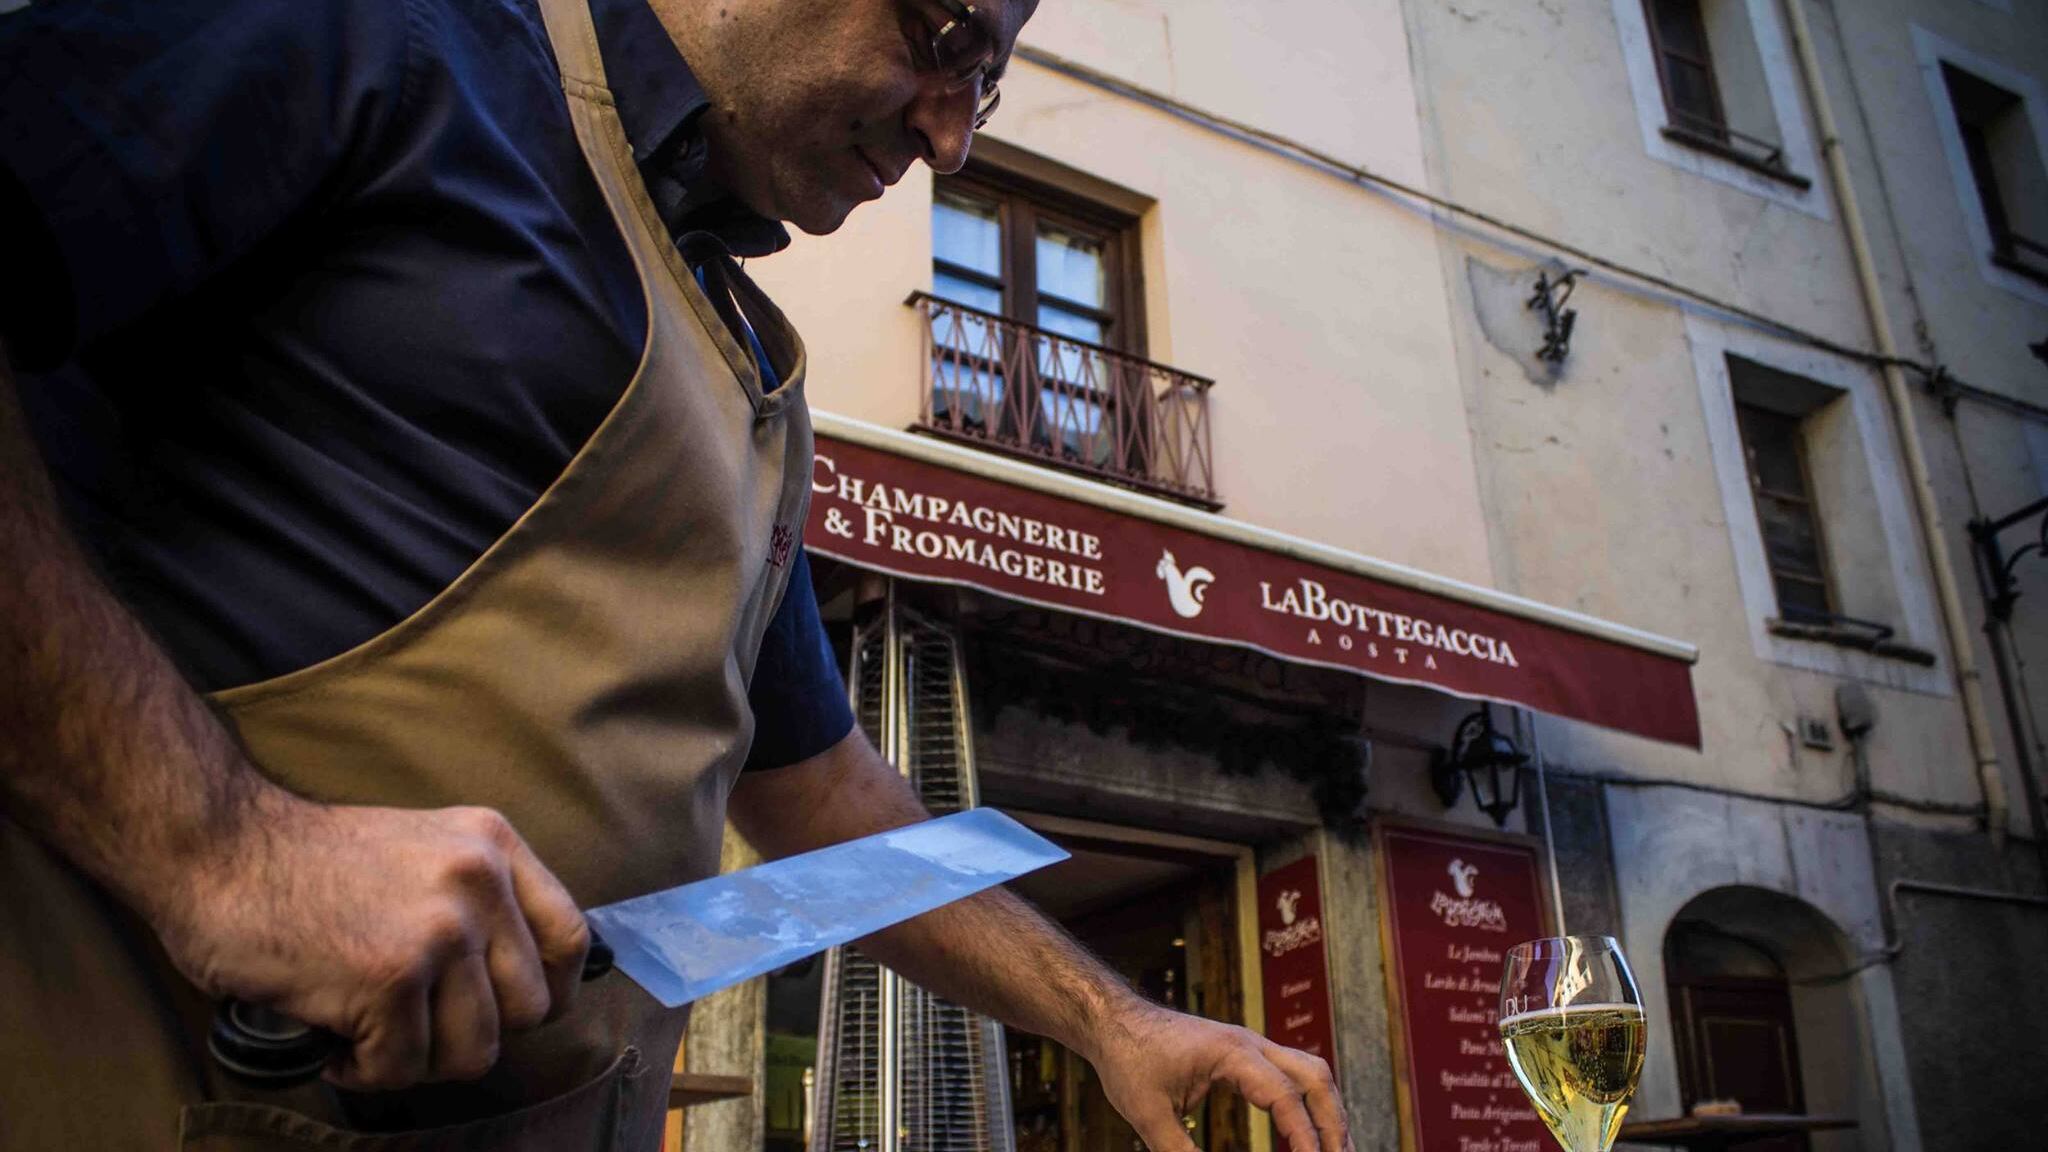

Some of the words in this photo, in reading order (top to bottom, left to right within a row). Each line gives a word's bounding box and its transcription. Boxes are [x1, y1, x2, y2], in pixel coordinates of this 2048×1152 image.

[812, 454, 1104, 561] CHAMPAGNERIE
[824, 506, 854, 540] &
[862, 504, 1106, 596] FROMAGERIE
[1306, 628, 1438, 670] AOSTA
